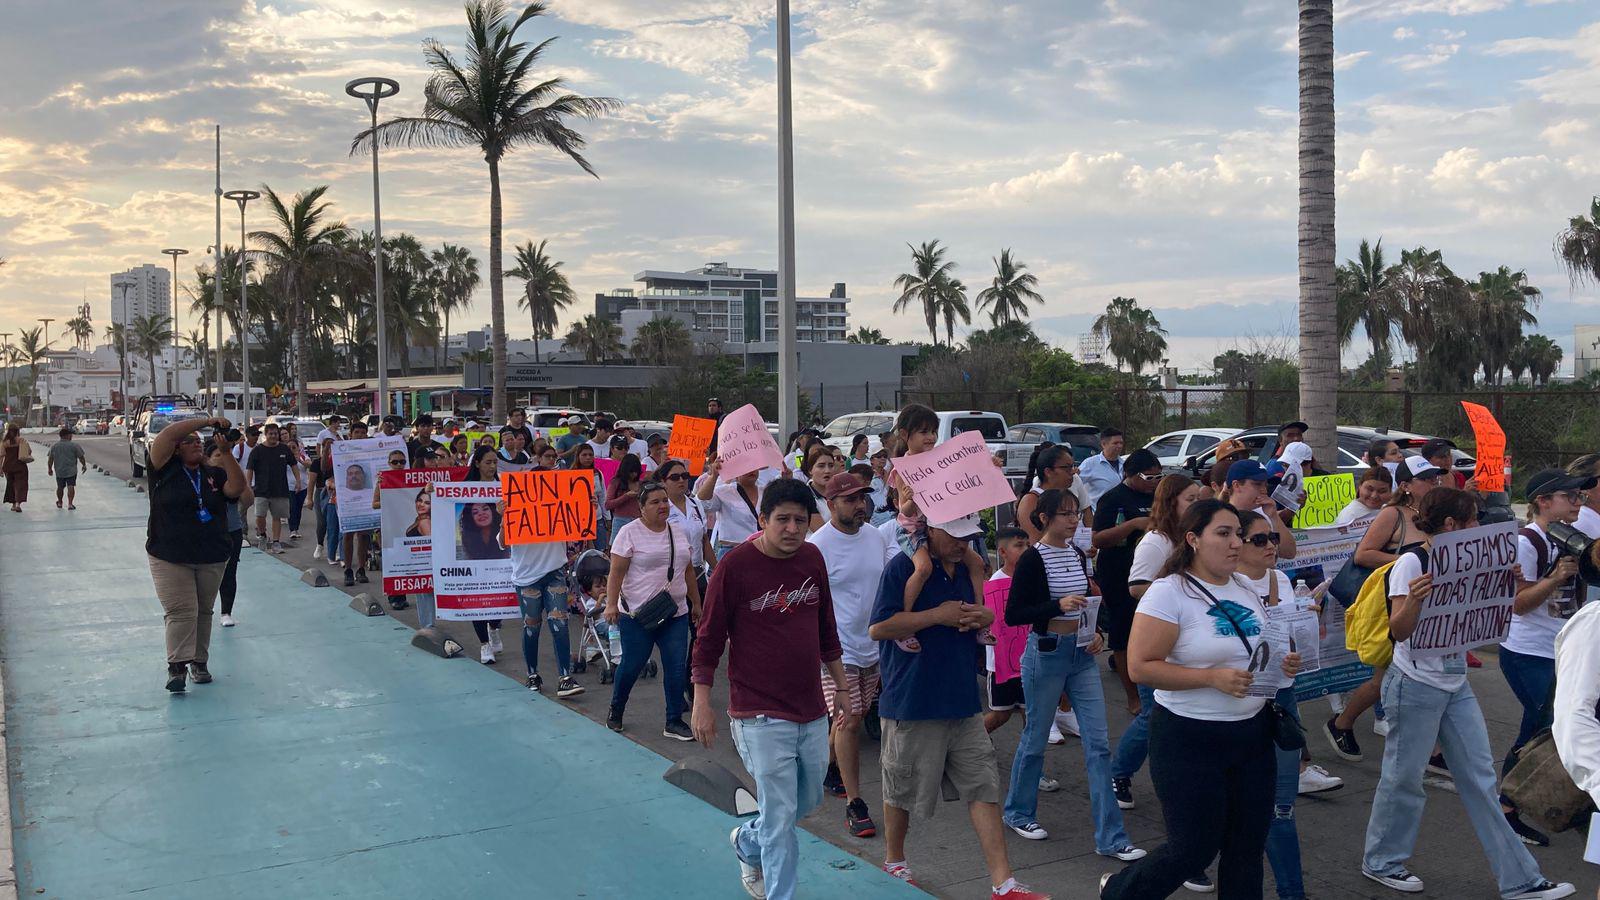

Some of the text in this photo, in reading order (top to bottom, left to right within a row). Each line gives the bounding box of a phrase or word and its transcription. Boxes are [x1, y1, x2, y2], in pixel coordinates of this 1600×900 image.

[742, 440, 758, 452] las
[405, 470, 451, 484] PERSONA
[902, 468, 934, 486] Hasta
[504, 474, 558, 507] AUN
[1307, 477, 1355, 504] ecilia
[1304, 502, 1345, 526] Crist
[1431, 532, 1516, 577] NO ESTAMOS
[394, 577, 434, 591] DESAPA
[440, 568, 472, 576] CHINA
[1470, 569, 1515, 604] FALTAN
[1412, 613, 1460, 650] CECILIA
